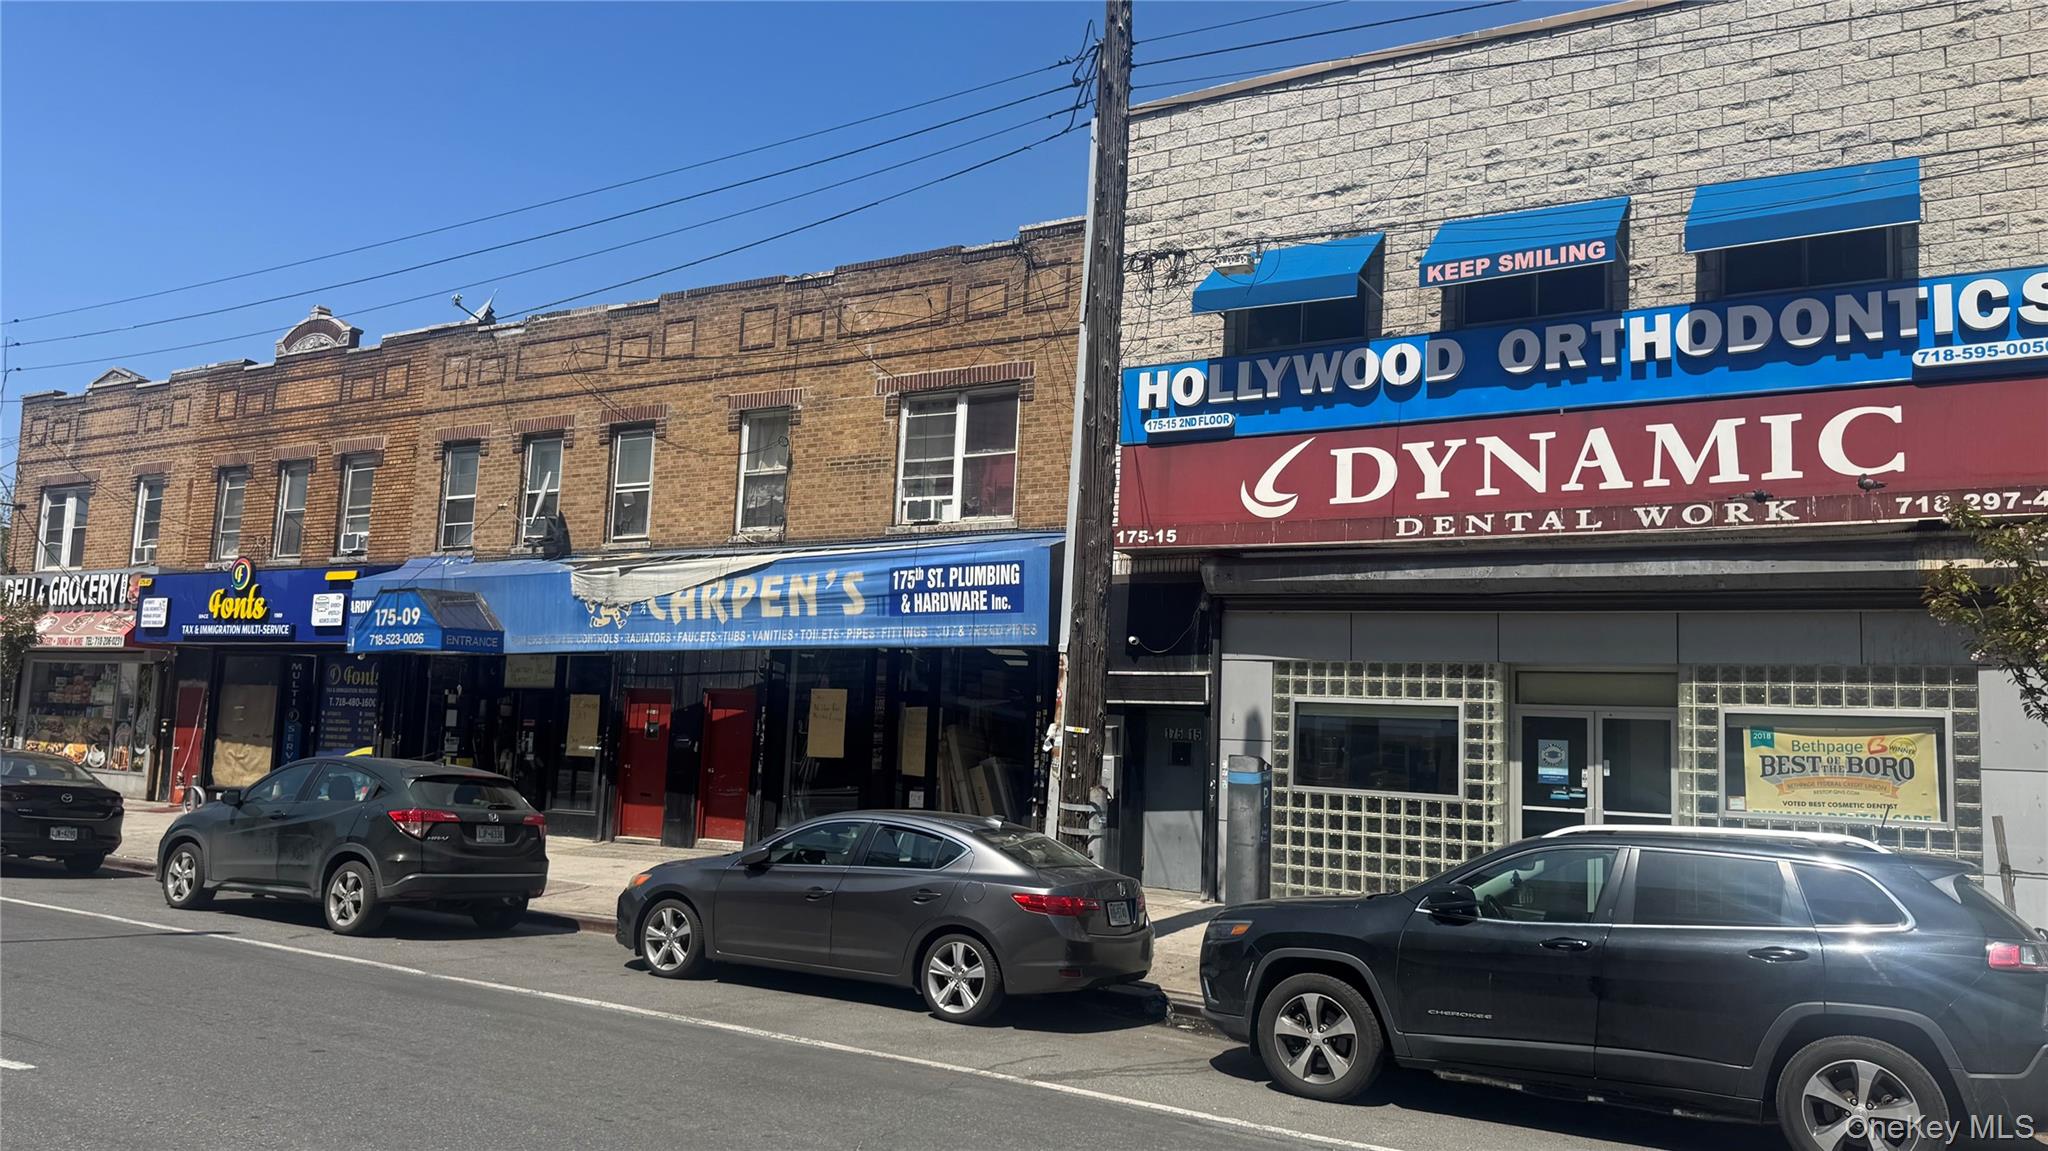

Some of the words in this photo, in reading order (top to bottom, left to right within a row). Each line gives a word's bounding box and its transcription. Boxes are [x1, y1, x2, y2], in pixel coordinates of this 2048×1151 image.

[1426, 257, 1491, 283] KEEP
[1498, 240, 1606, 273] SMILING
[1138, 338, 1466, 411] HOLLYWOOD
[1498, 272, 2048, 376] ORTHODONTICS
[1918, 340, 2048, 364] 718-595-005
[1147, 418, 1177, 431] 175-15
[1179, 416, 1197, 429] 2ND
[1198, 413, 1230, 427] FLOOR
[1329, 405, 1905, 505] DYNAMIC
[1395, 509, 1603, 537] DENTAL
[1633, 500, 1800, 529] WORK
[1116, 528, 1177, 544] 175-15
[893, 566, 924, 589] 175th
[927, 569, 945, 588] ST.
[949, 564, 1020, 587] PLUMBING
[4, 577, 37, 608] DELI
[49, 573, 120, 606] GROCERY
[208, 584, 268, 620] Fonts
[901, 597, 911, 614] &
[914, 590, 988, 613] HARDWARE
[991, 594, 1011, 611] Inc.
[374, 607, 421, 627] 175-09
[182, 625, 194, 634] TAX
[194, 625, 199, 634] &
[200, 624, 240, 634] IMMIGRATION
[241, 624, 290, 634] MULTI-SERVICE
[625, 632, 672, 644] RADIATORS
[677, 632, 716, 644] FAUCETS
[723, 631, 746, 642] TUBS
[752, 630, 794, 641] VANITIES
[801, 628, 839, 640] TOILETS
[847, 627, 875, 639] PIPES
[881, 626, 928, 638] FITTINGS
[369, 633, 425, 646] 718-523-0026
[446, 635, 498, 647] ENTRANCE
[291, 662, 303, 705] MULTI
[1753, 731, 1771, 741] 2018
[1791, 739, 1863, 755] Bethpage
[1759, 754, 1822, 778] BEST
[1821, 765, 1844, 773] THE
[1826, 756, 1841, 764] OF
[1846, 755, 1915, 781] BORO
[1817, 780, 1842, 788] FEDERAL
[1865, 782, 1888, 792] UNION
[1827, 801, 1865, 809] COSMETIC
[1866, 802, 1898, 810] DENTIST
[1427, 1009, 1493, 1020] CHEROKEE
